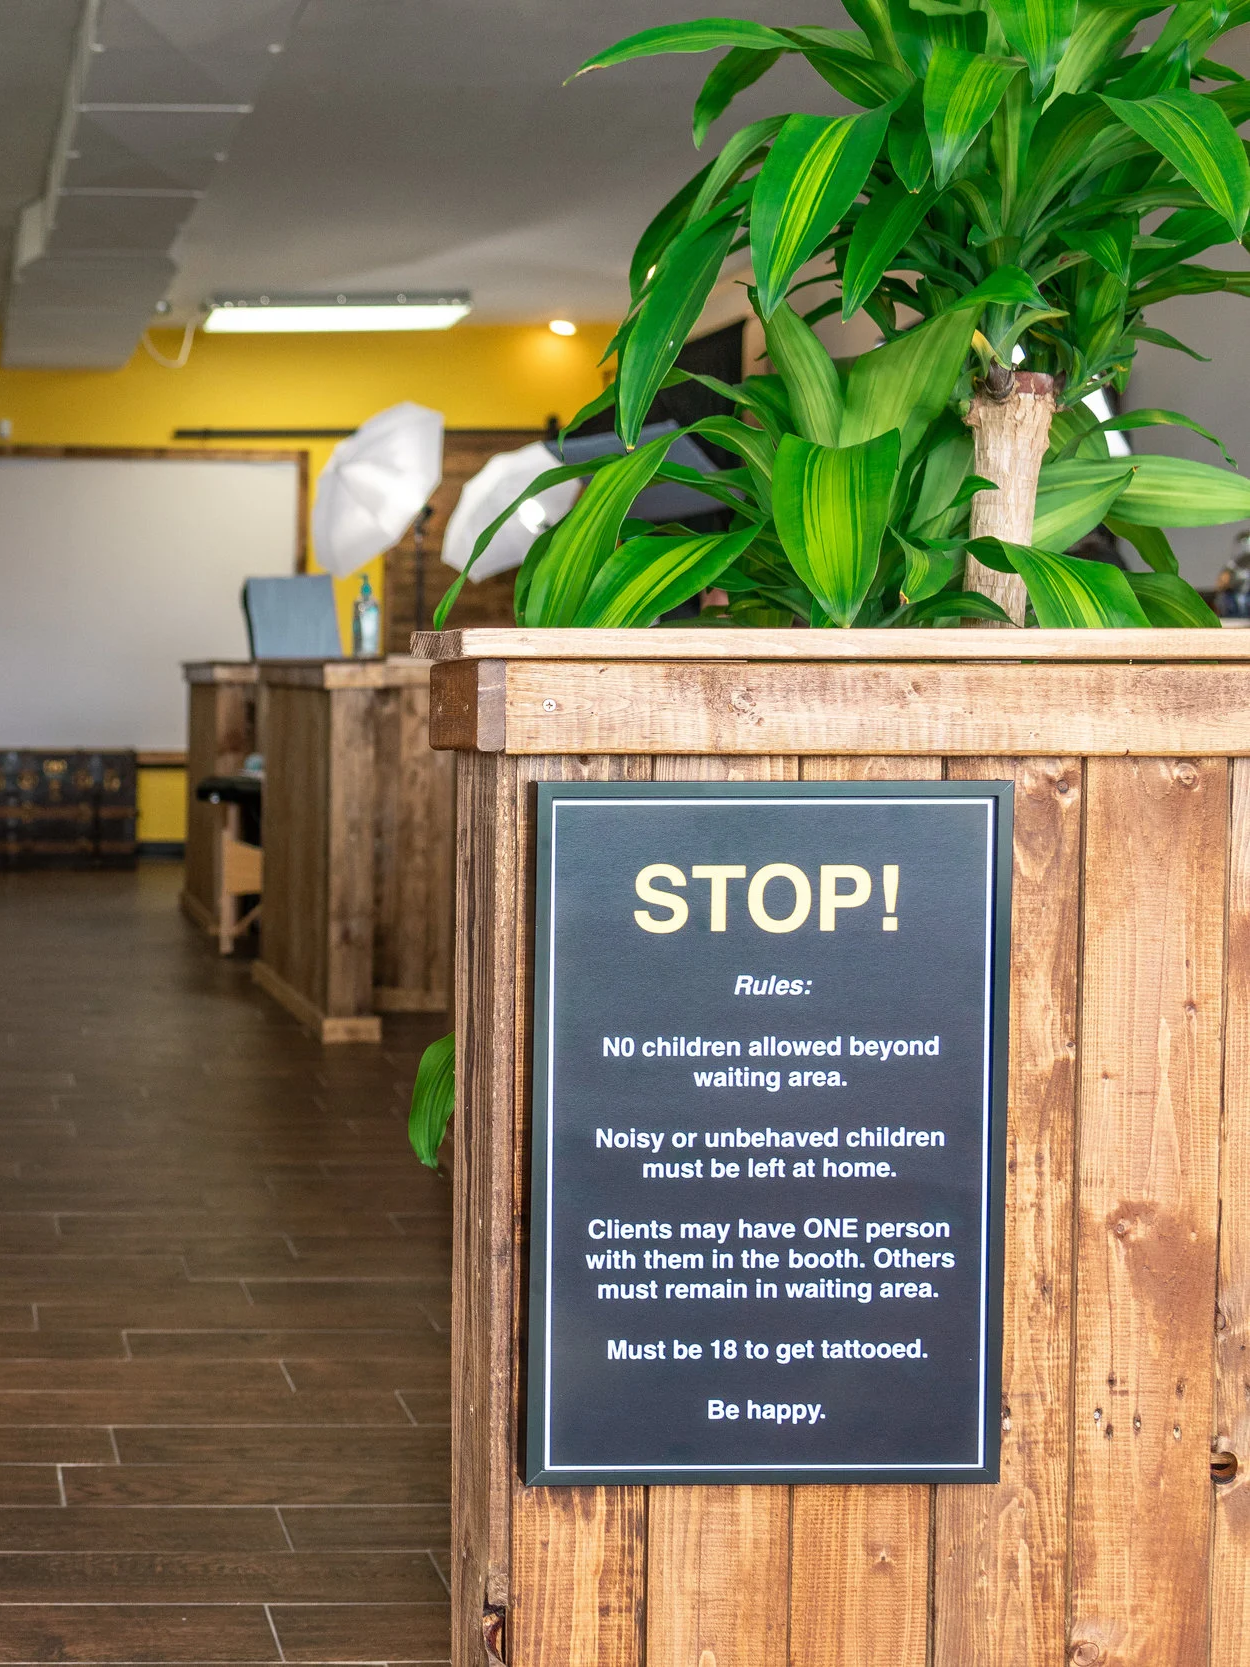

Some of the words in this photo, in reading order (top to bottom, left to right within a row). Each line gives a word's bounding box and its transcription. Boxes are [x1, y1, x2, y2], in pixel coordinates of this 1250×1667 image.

[633, 862, 900, 935] STOP!
[733, 974, 813, 996] Rules:
[641, 1036, 741, 1058] children
[748, 1035, 842, 1057] allowed
[849, 1035, 940, 1062] beyond
[693, 1066, 781, 1093] waiting
[787, 1070, 848, 1088] area.
[595, 1127, 665, 1154] Noisy
[671, 1131, 698, 1149] or
[704, 1126, 839, 1148] unbehaved
[845, 1126, 945, 1148] children
[642, 1159, 704, 1179] must
[710, 1157, 741, 1179] be
[747, 1157, 786, 1179] left
[792, 1158, 816, 1178] at
[822, 1157, 897, 1178] home.
[587, 1218, 673, 1240] Clients
[680, 1223, 731, 1245] may
[738, 1218, 796, 1239] have
[803, 1217, 859, 1239] ONE
[865, 1221, 950, 1244] person
[585, 1249, 636, 1270] with
[643, 1249, 704, 1270] them
[712, 1248, 734, 1269] in
[740, 1248, 780, 1269] the
[788, 1248, 866, 1269] booth.
[873, 1247, 956, 1269] Others
[597, 1280, 659, 1300] must
[665, 1278, 748, 1300] remain
[755, 1278, 778, 1299] in
[784, 1278, 872, 1304] waiting
[879, 1282, 939, 1299] area.
[607, 1339, 667, 1360] Must
[673, 1339, 703, 1360] be
[710, 1339, 738, 1360] 18
[744, 1339, 769, 1360] to
[775, 1339, 815, 1365] get
[820, 1338, 928, 1359] tattooed.
[707, 1399, 740, 1420] Be
[747, 1399, 826, 1425] happy.
